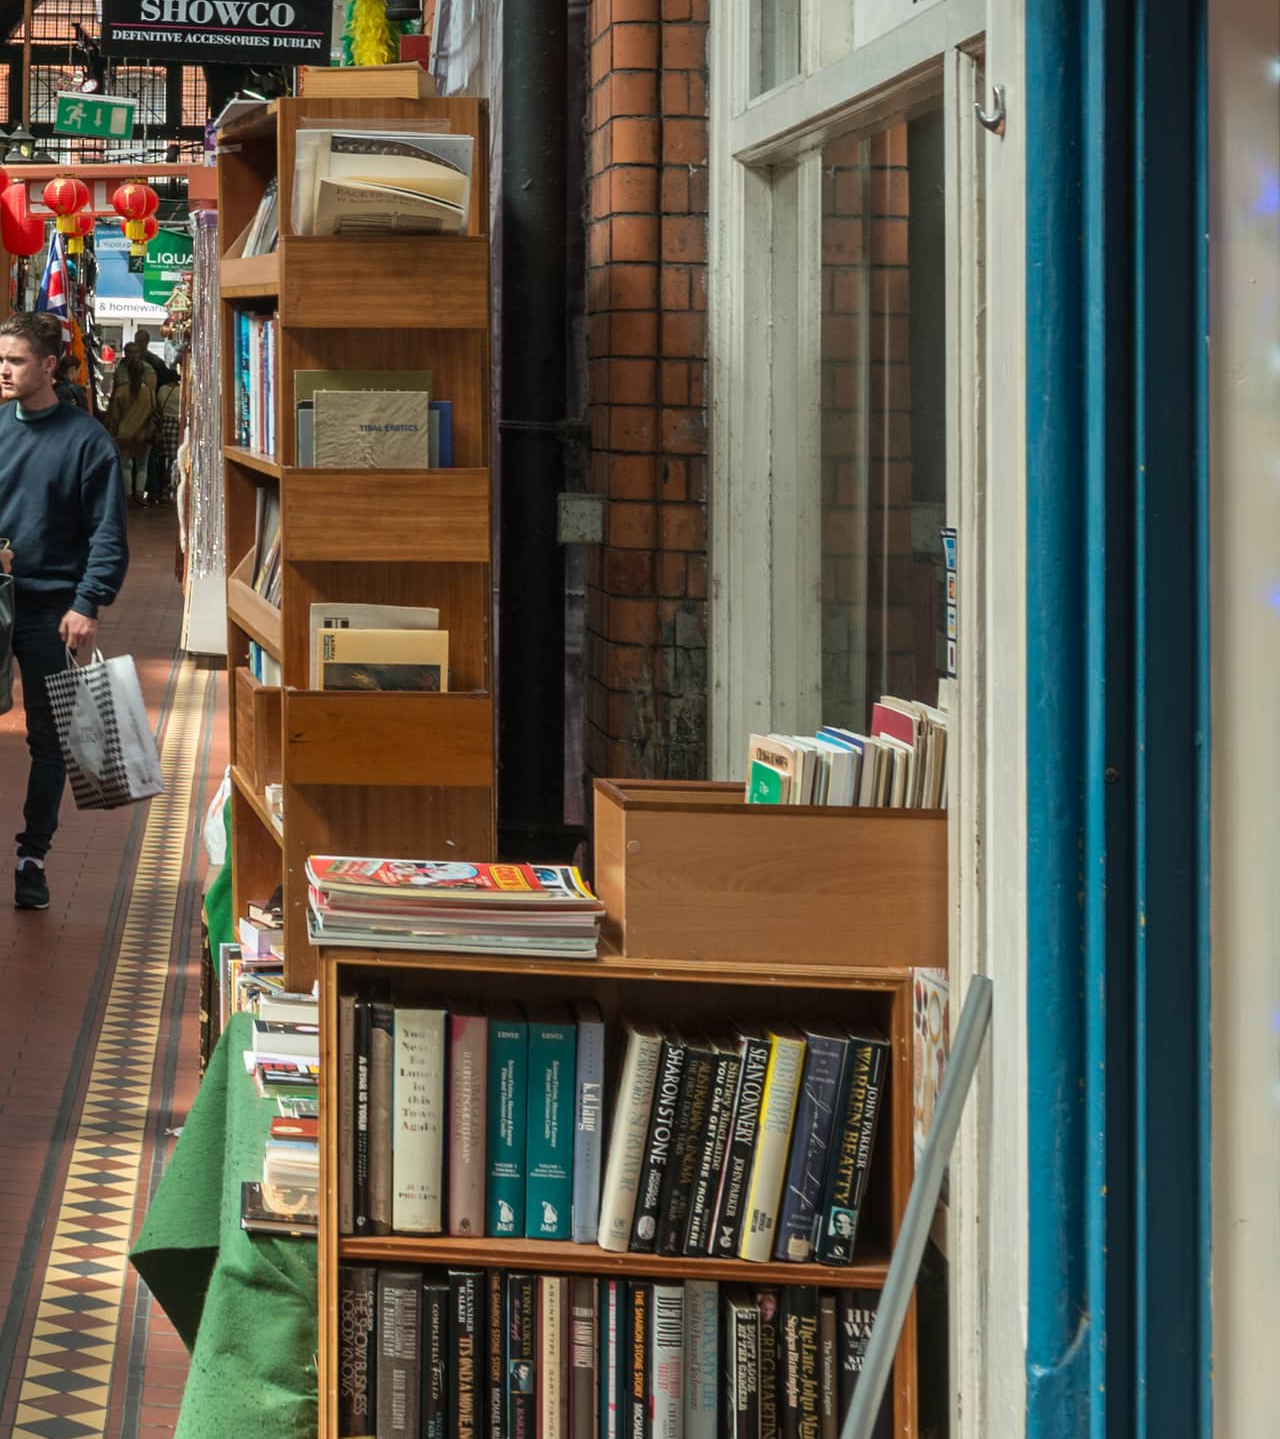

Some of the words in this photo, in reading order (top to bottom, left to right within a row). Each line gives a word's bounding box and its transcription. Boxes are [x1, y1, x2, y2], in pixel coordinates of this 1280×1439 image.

[112, 30, 182, 43] DEFINITIVE
[184, 33, 269, 47] ACCESSORIES
[273, 37, 321, 49] DUBLIN
[663, 1048, 685, 1106] SHARON
[716, 1060, 727, 1085] YOU
[745, 1047, 768, 1083] SEAN
[712, 1087, 723, 1111] CAN
[722, 1061, 739, 1106] Shirley
[848, 1047, 872, 1129] WARREN
[734, 1082, 760, 1147] CONNERY
[866, 1084, 880, 1120] JOHN
[649, 1107, 675, 1166] STONE
[707, 1115, 719, 1137] GET
[712, 1109, 731, 1171] MacLaine
[701, 1141, 715, 1177] THERE
[857, 1121, 875, 1169] PARKER
[733, 1157, 746, 1179] JOHN
[833, 1130, 859, 1207] BEATTY
[695, 1180, 708, 1213] FROM
[726, 1179, 743, 1217] PARKER
[689, 1215, 702, 1247] HERE
[355, 1291, 368, 1314] THE
[523, 1284, 532, 1315] TONY
[635, 1290, 645, 1306] THE
[354, 1315, 368, 1359] SHOW
[523, 1316, 532, 1356] CURTIS
[634, 1307, 645, 1342] SHARON
[656, 1296, 683, 1348] DETOUR
[634, 1344, 645, 1370] STONE
[761, 1323, 775, 1371] GREG
[801, 1343, 817, 1374] Late
[633, 1371, 644, 1398] STORY
